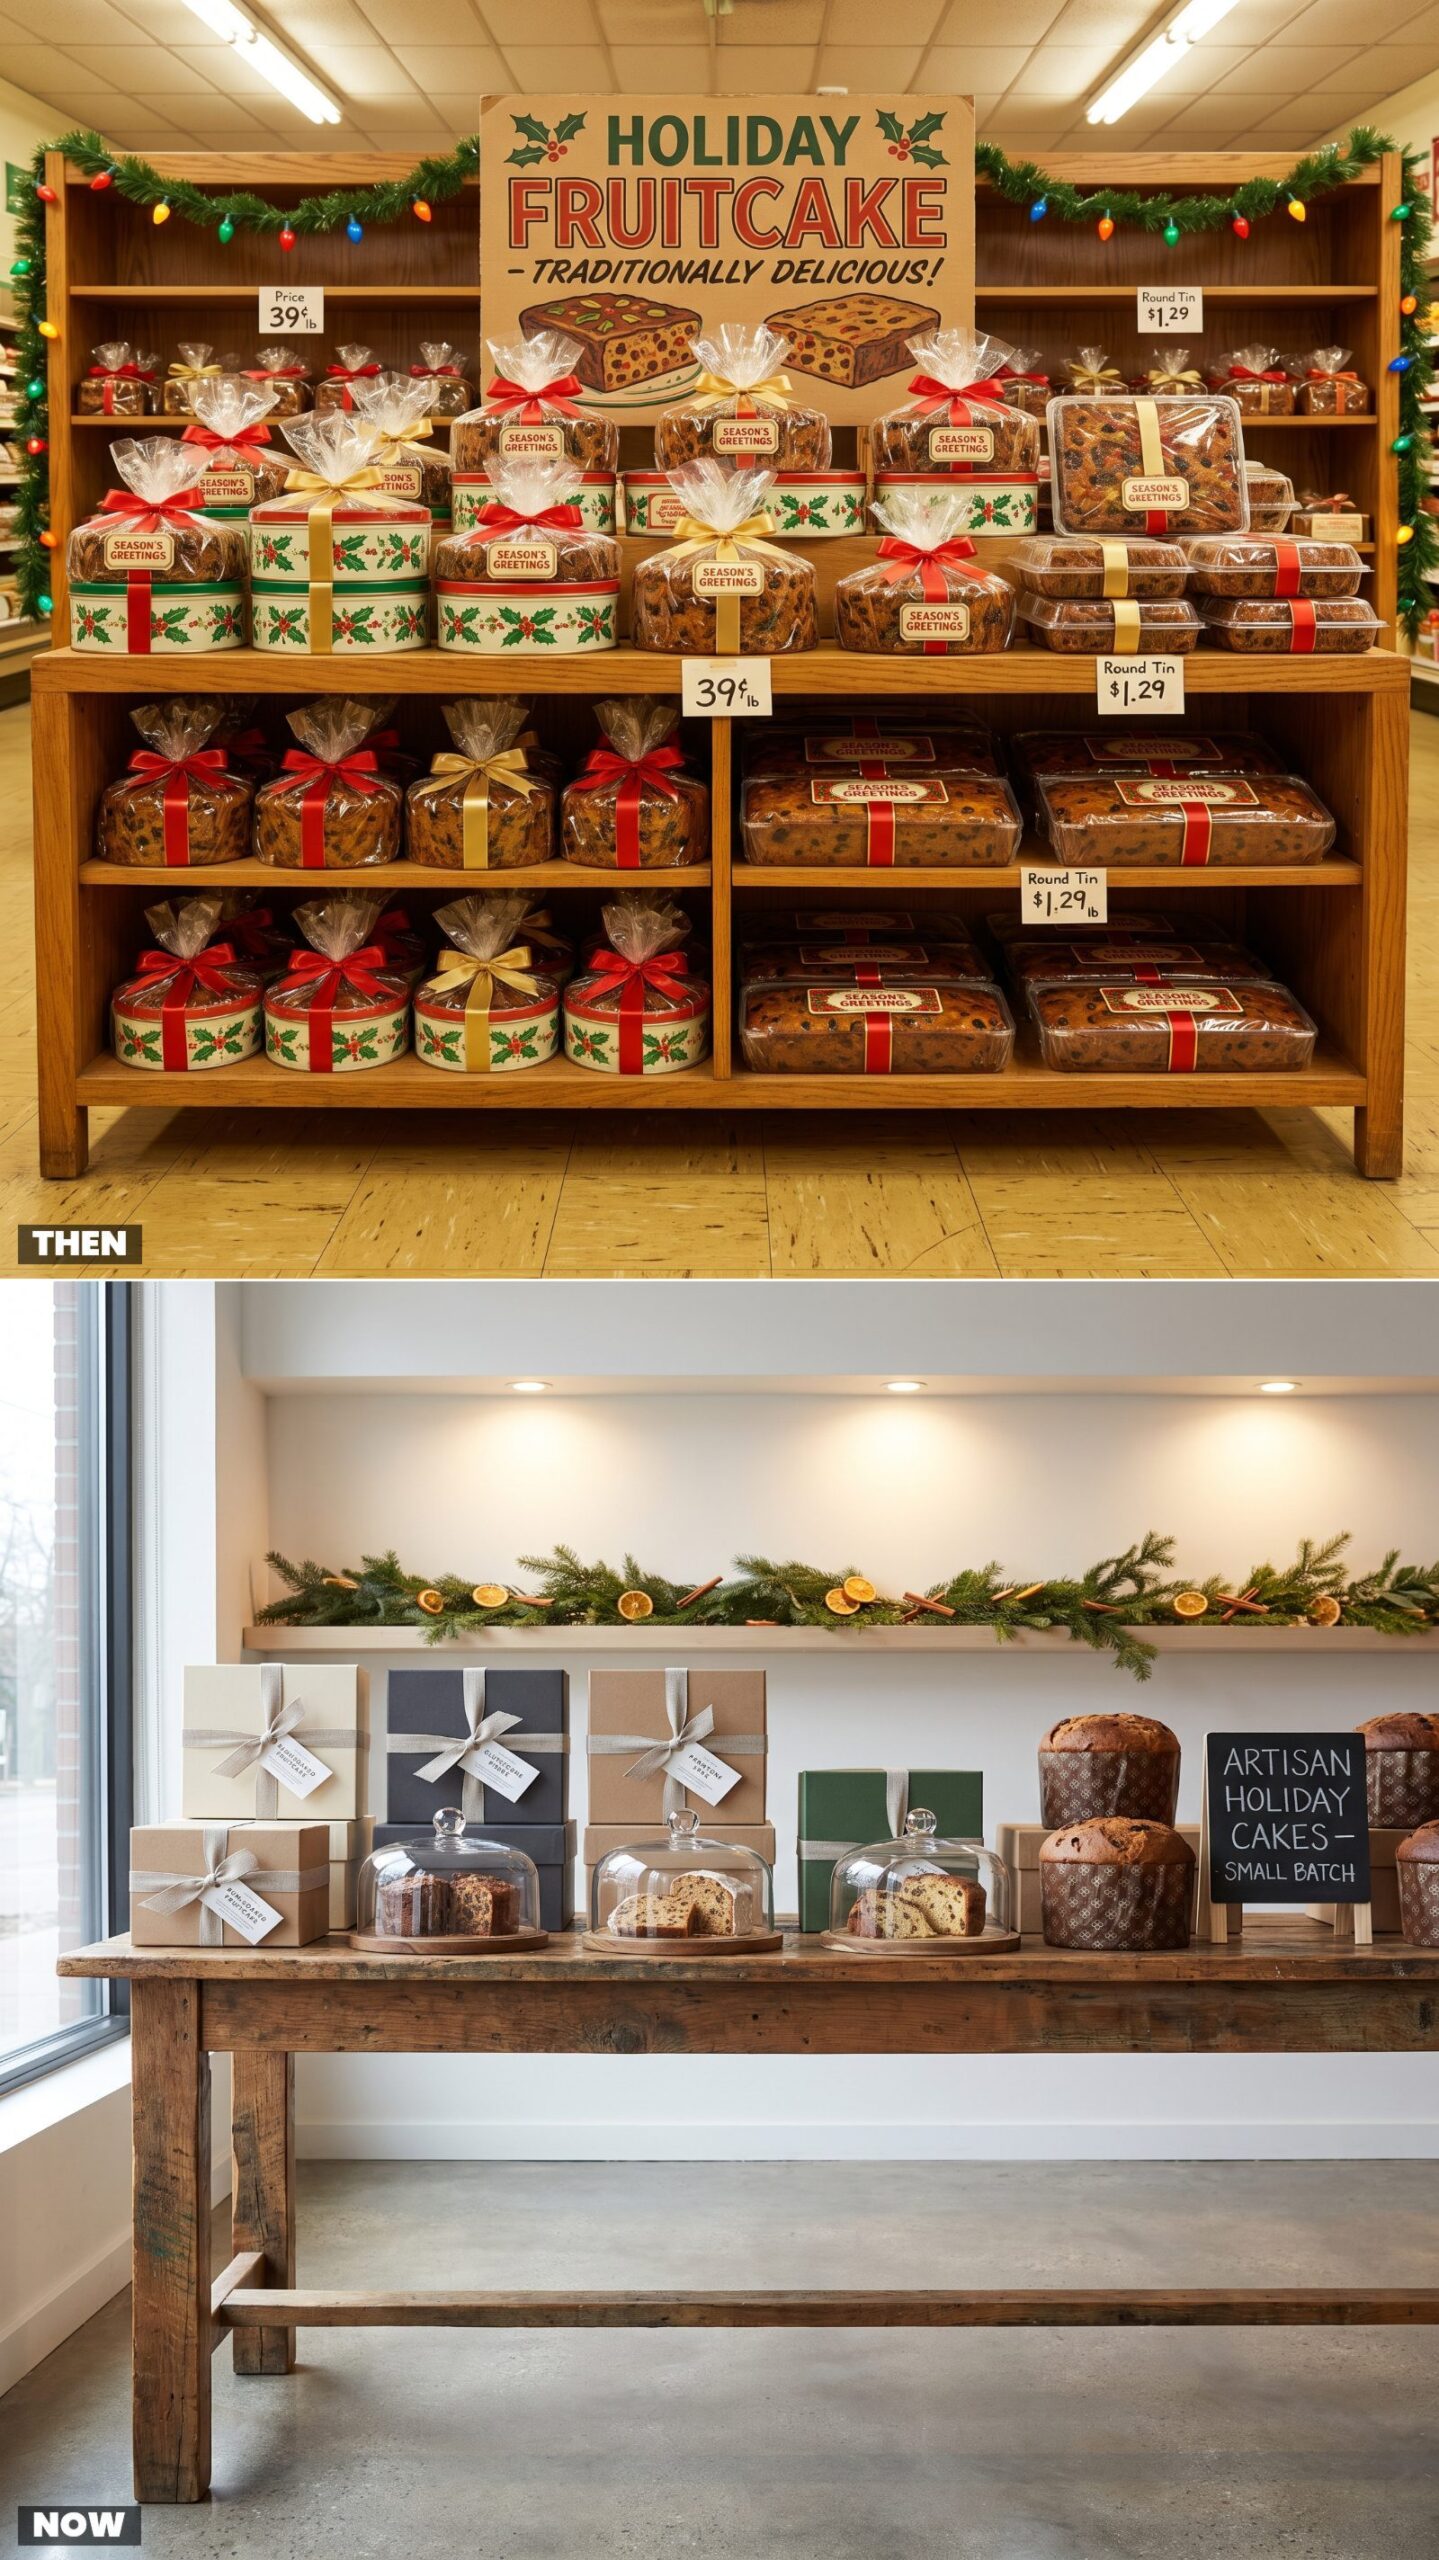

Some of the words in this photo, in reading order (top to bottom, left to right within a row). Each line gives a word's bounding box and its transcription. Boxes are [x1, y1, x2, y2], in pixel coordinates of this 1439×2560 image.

[608, 115, 861, 166] HOLIDAY
[508, 176, 947, 249] FRUITCAKE
[770, 257, 945, 287] DELICIOUS!
[275, 290, 305, 302] Price
[1142, 291, 1175, 303] Round
[1178, 291, 1196, 302] Tin
[270, 306, 308, 328] 39¢
[306, 318, 317, 329] lb
[1148, 307, 1189, 328] $1.29
[723, 427, 770, 436] SEASON'S
[508, 433, 554, 442] SEASON'S
[719, 437, 773, 445] GREETINGS
[938, 435, 985, 444] SEASON'S
[504, 443, 558, 452] GREETINGS
[934, 444, 988, 453] GREETINGS
[384, 474, 413, 482] SON'S
[1131, 484, 1178, 493] SEASON'S
[1128, 493, 1182, 502] GREETINGS
[113, 541, 163, 550] SEASON'S
[110, 551, 167, 560] GREETINGS
[497, 550, 547, 559] SEASON'S
[493, 560, 550, 569] GREETINGS
[703, 567, 754, 577] SEASON'S
[699, 577, 757, 587] GREETINGS
[909, 611, 960, 620] SEASON'S
[906, 621, 963, 631] GREETINGS
[1104, 661, 1146, 674] Round
[1152, 661, 1175, 674] Tin
[696, 678, 748, 707] 39¢
[747, 694, 760, 707] lb
[1110, 679, 1165, 707] $1.29
[842, 790, 918, 798] GREETINGS
[1028, 872, 1069, 885] Round
[1075, 872, 1098, 884] Tin
[1033, 890, 1086, 917] $1.29
[1087, 906, 1099, 918] lb
[1223, 1747, 1351, 1776] ARTISAN
[1225, 1785, 1351, 1816] HOLIDAY
[1224, 1861, 1287, 1881] SMALL
[1293, 1862, 1356, 1883] BATCH
